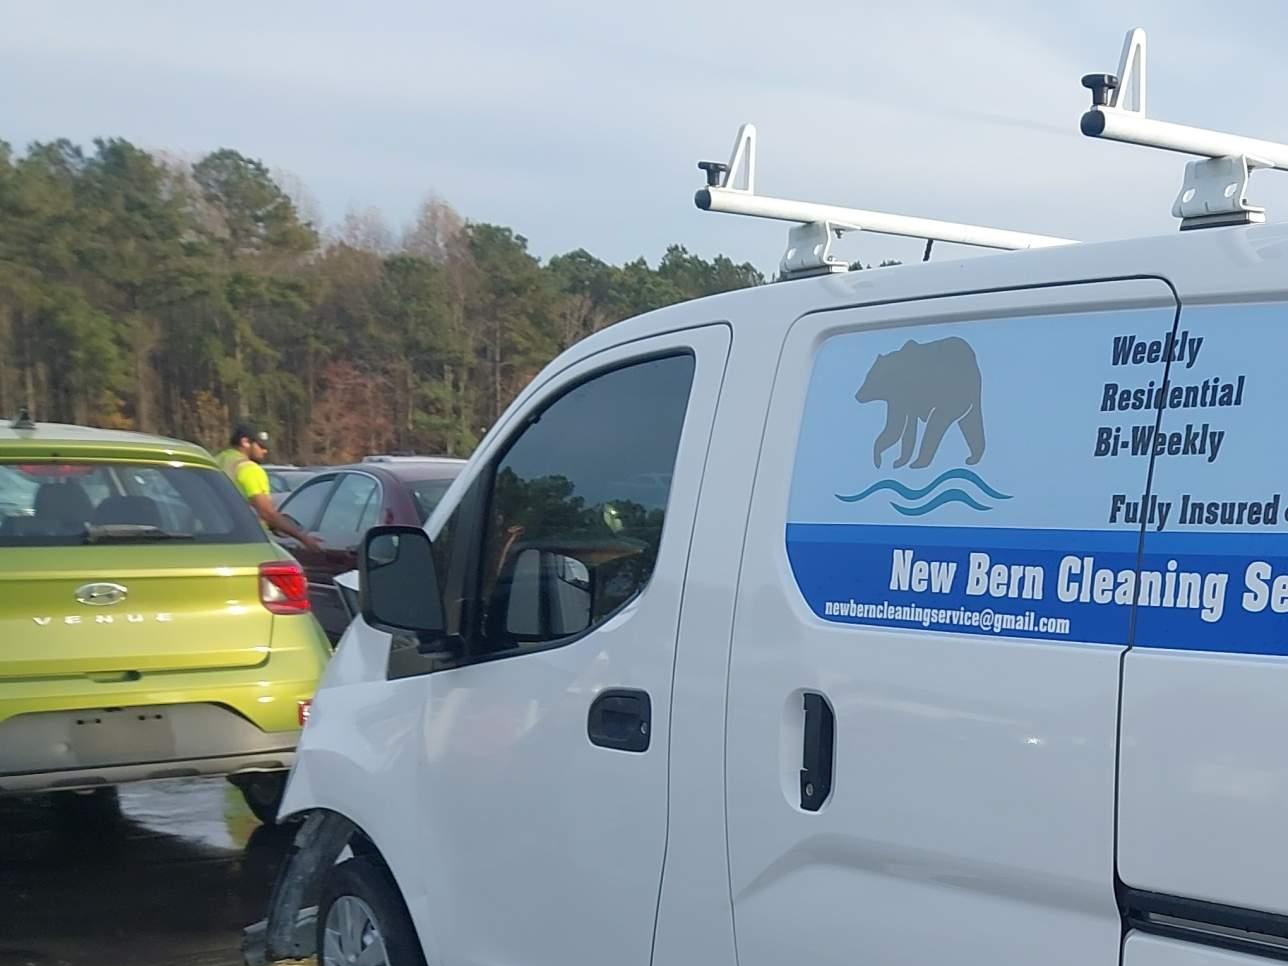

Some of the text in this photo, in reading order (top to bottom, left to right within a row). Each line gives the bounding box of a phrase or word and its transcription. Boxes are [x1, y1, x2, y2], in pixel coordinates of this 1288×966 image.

[1111, 331, 1203, 369] Weekly
[1100, 376, 1246, 412] Residential
[1094, 424, 1225, 462] Bi-Weekly
[1108, 494, 1172, 532] Fully
[1179, 494, 1280, 525] Insured
[889, 549, 957, 594] New
[966, 552, 1044, 600] Bern
[1057, 555, 1229, 623] Cleaning
[32, 612, 173, 626] VENUE
[824, 599, 1071, 635] newberncleaningservice@gmail.com
